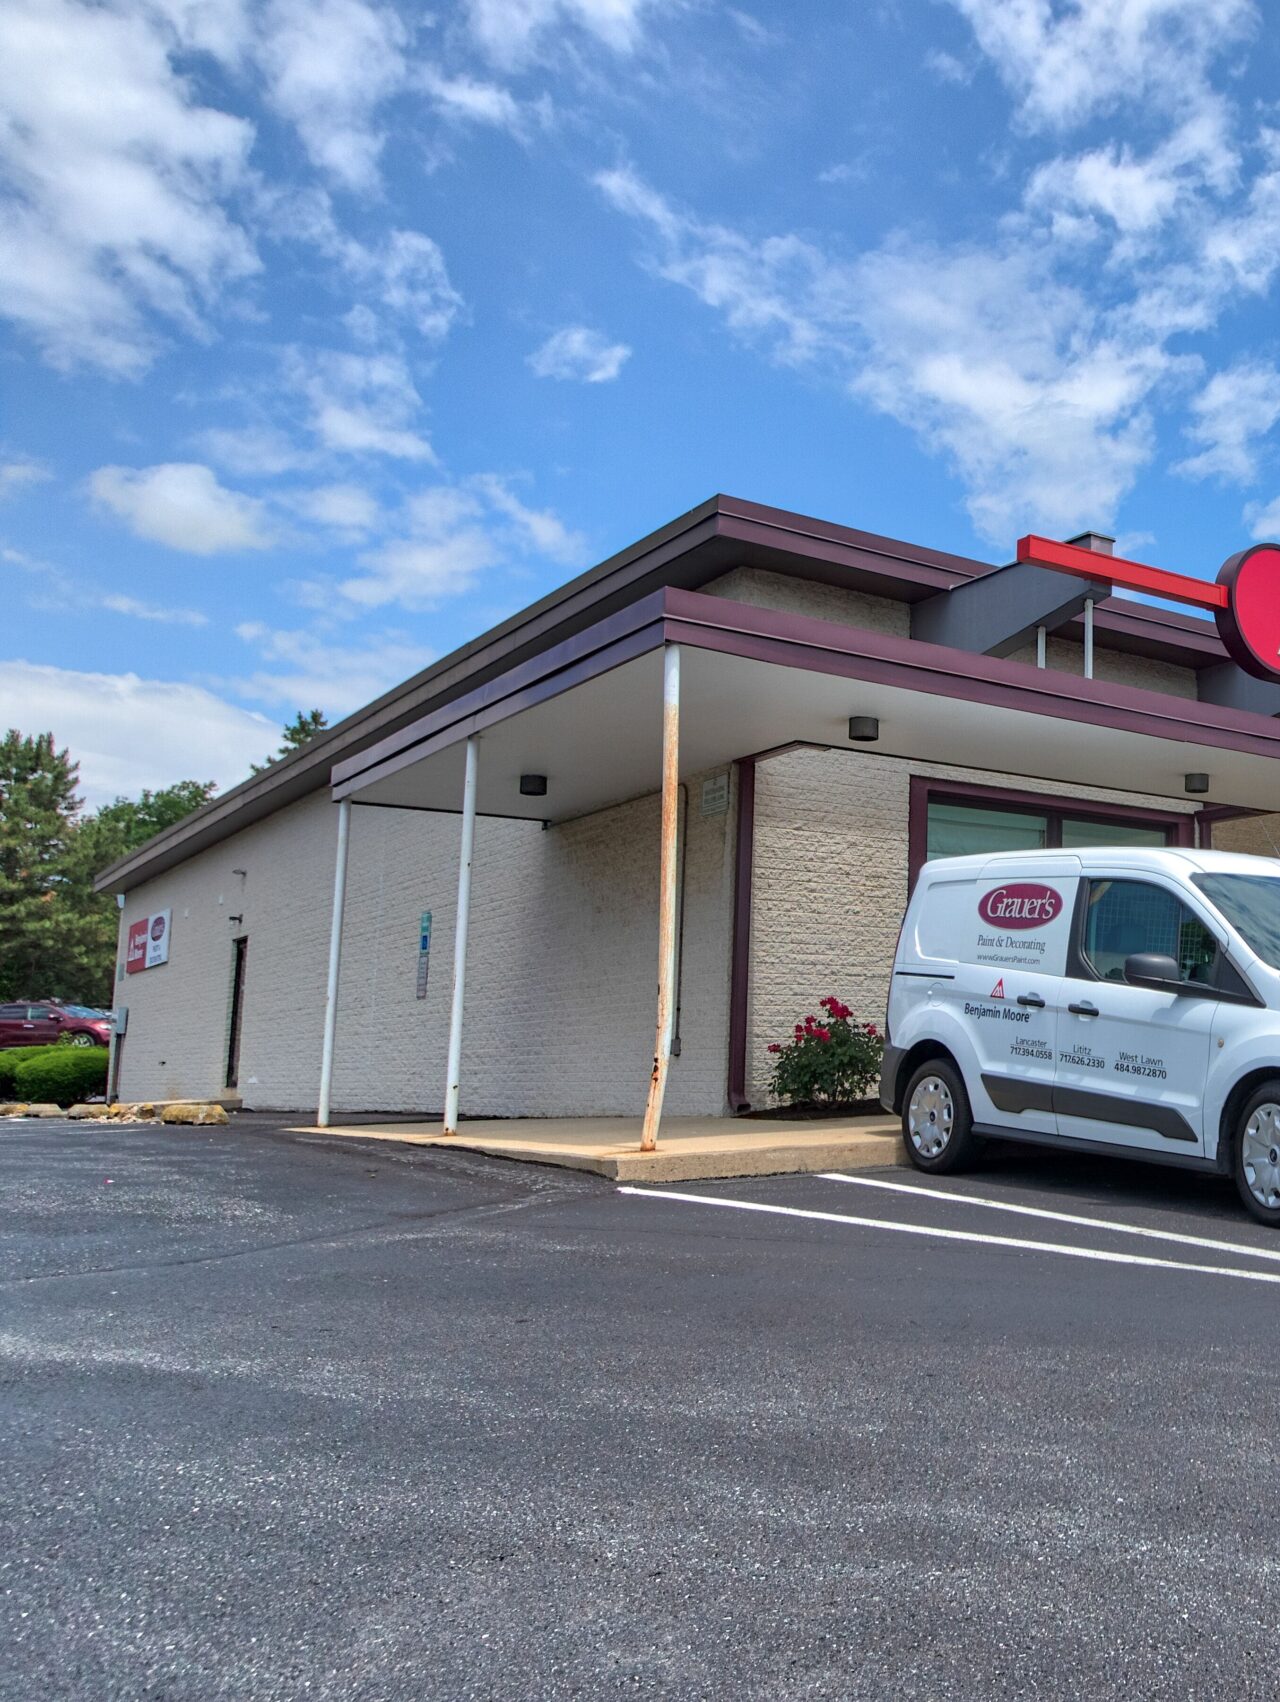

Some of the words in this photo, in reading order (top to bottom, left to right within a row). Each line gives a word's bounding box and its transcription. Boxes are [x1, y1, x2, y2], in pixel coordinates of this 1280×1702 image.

[986, 889, 1055, 919] Grauer's
[977, 934, 994, 947] Paint
[995, 936, 1004, 948] &
[1005, 936, 1046, 954] Decorating
[964, 1003, 1000, 1019] Benjamin
[1015, 1036, 1047, 1048] Lancaster
[1073, 1044, 1091, 1055] Lititz
[1060, 1053, 1105, 1069] 717.626.2330
[1119, 1051, 1138, 1063] West
[1140, 1054, 1163, 1066] Lawn
[1114, 1063, 1167, 1079] 484.987.2870
